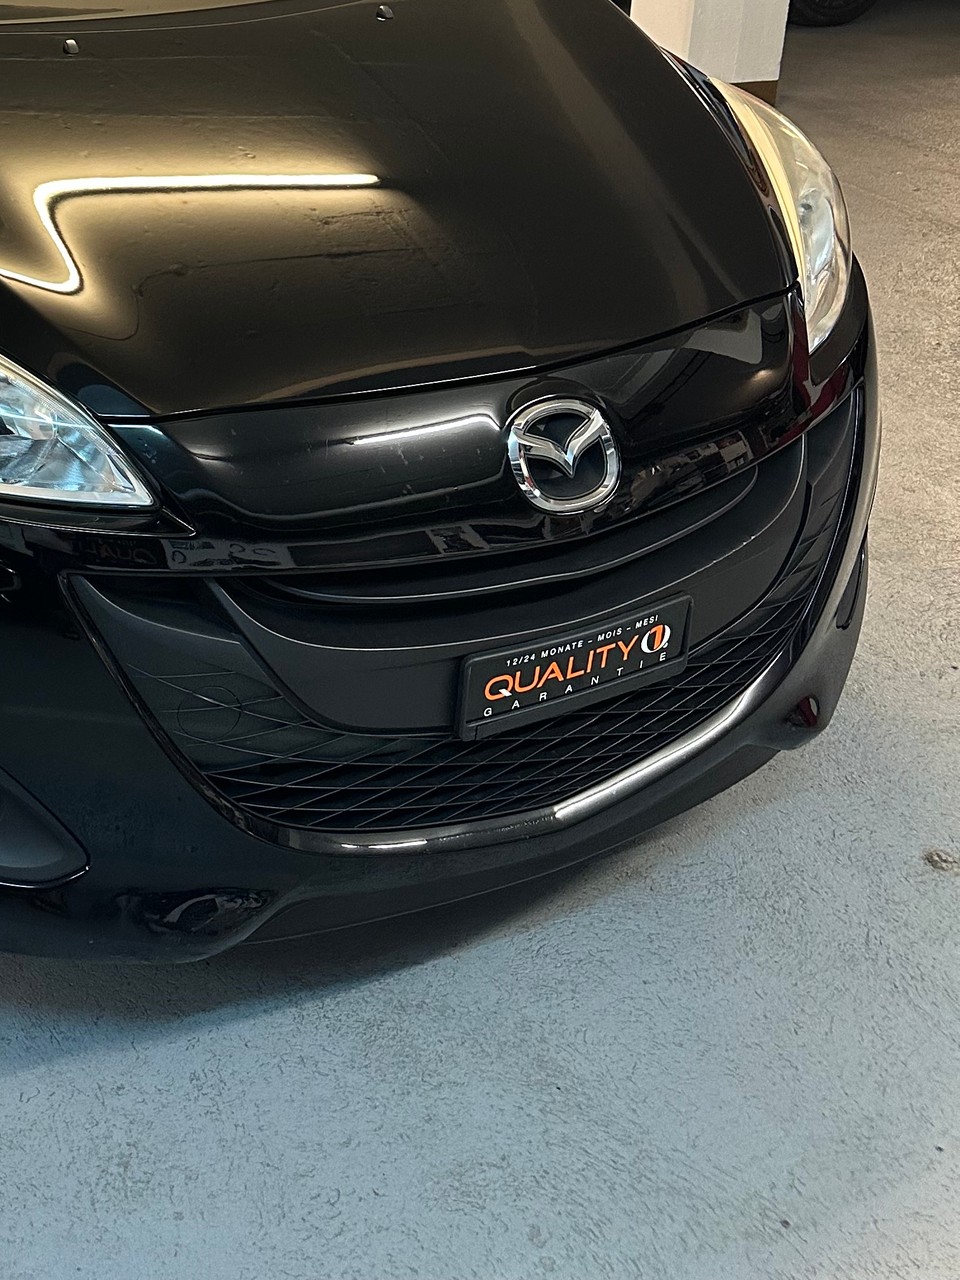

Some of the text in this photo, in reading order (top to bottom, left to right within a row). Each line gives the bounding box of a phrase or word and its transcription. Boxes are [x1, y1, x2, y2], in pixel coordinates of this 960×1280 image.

[484, 634, 640, 701] QUALITY
[506, 653, 536, 667] 12/24
[541, 640, 583, 659] MONATE
[597, 627, 622, 642] MOIS
[635, 614, 659, 629] MESI
[483, 651, 667, 717] GARANTIE
